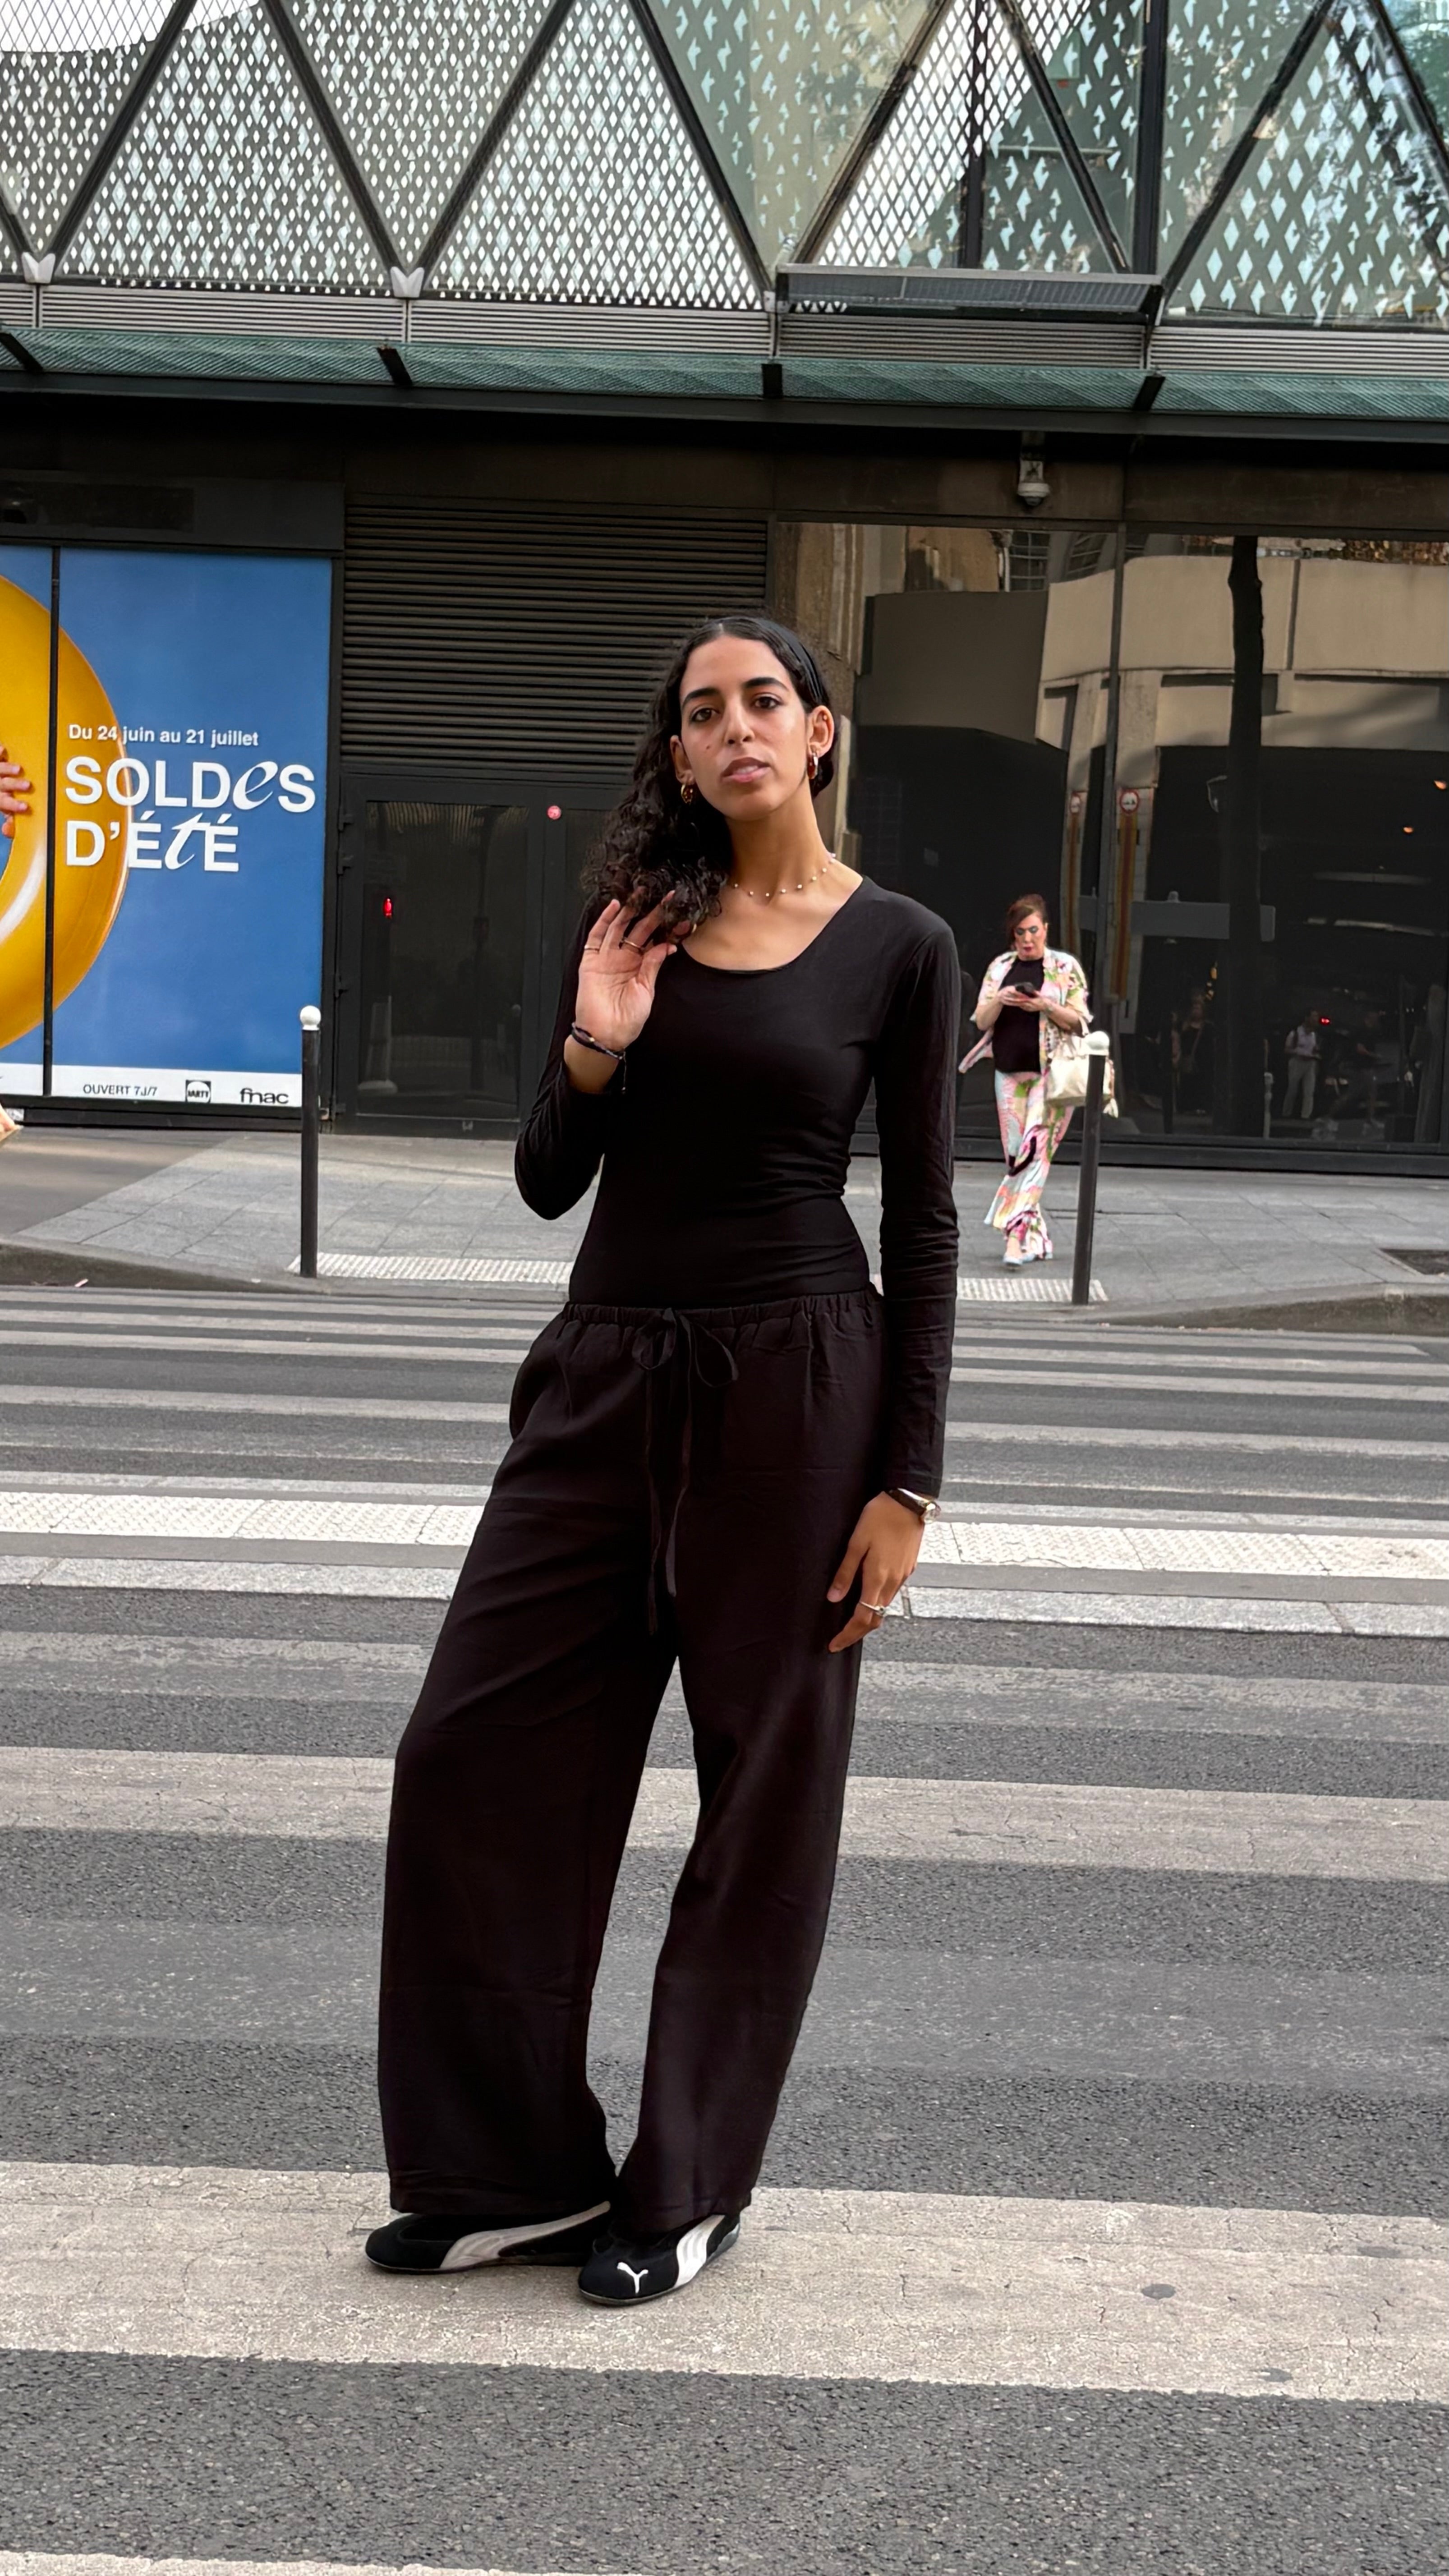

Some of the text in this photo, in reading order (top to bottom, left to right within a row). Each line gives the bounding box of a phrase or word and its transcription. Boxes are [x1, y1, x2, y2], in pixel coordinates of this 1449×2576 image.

[69, 724, 258, 749] Du 24 juin au 21 juillet
[83, 1084, 157, 1096] OUVERT 7J/7
[240, 1088, 289, 1104] fnac
